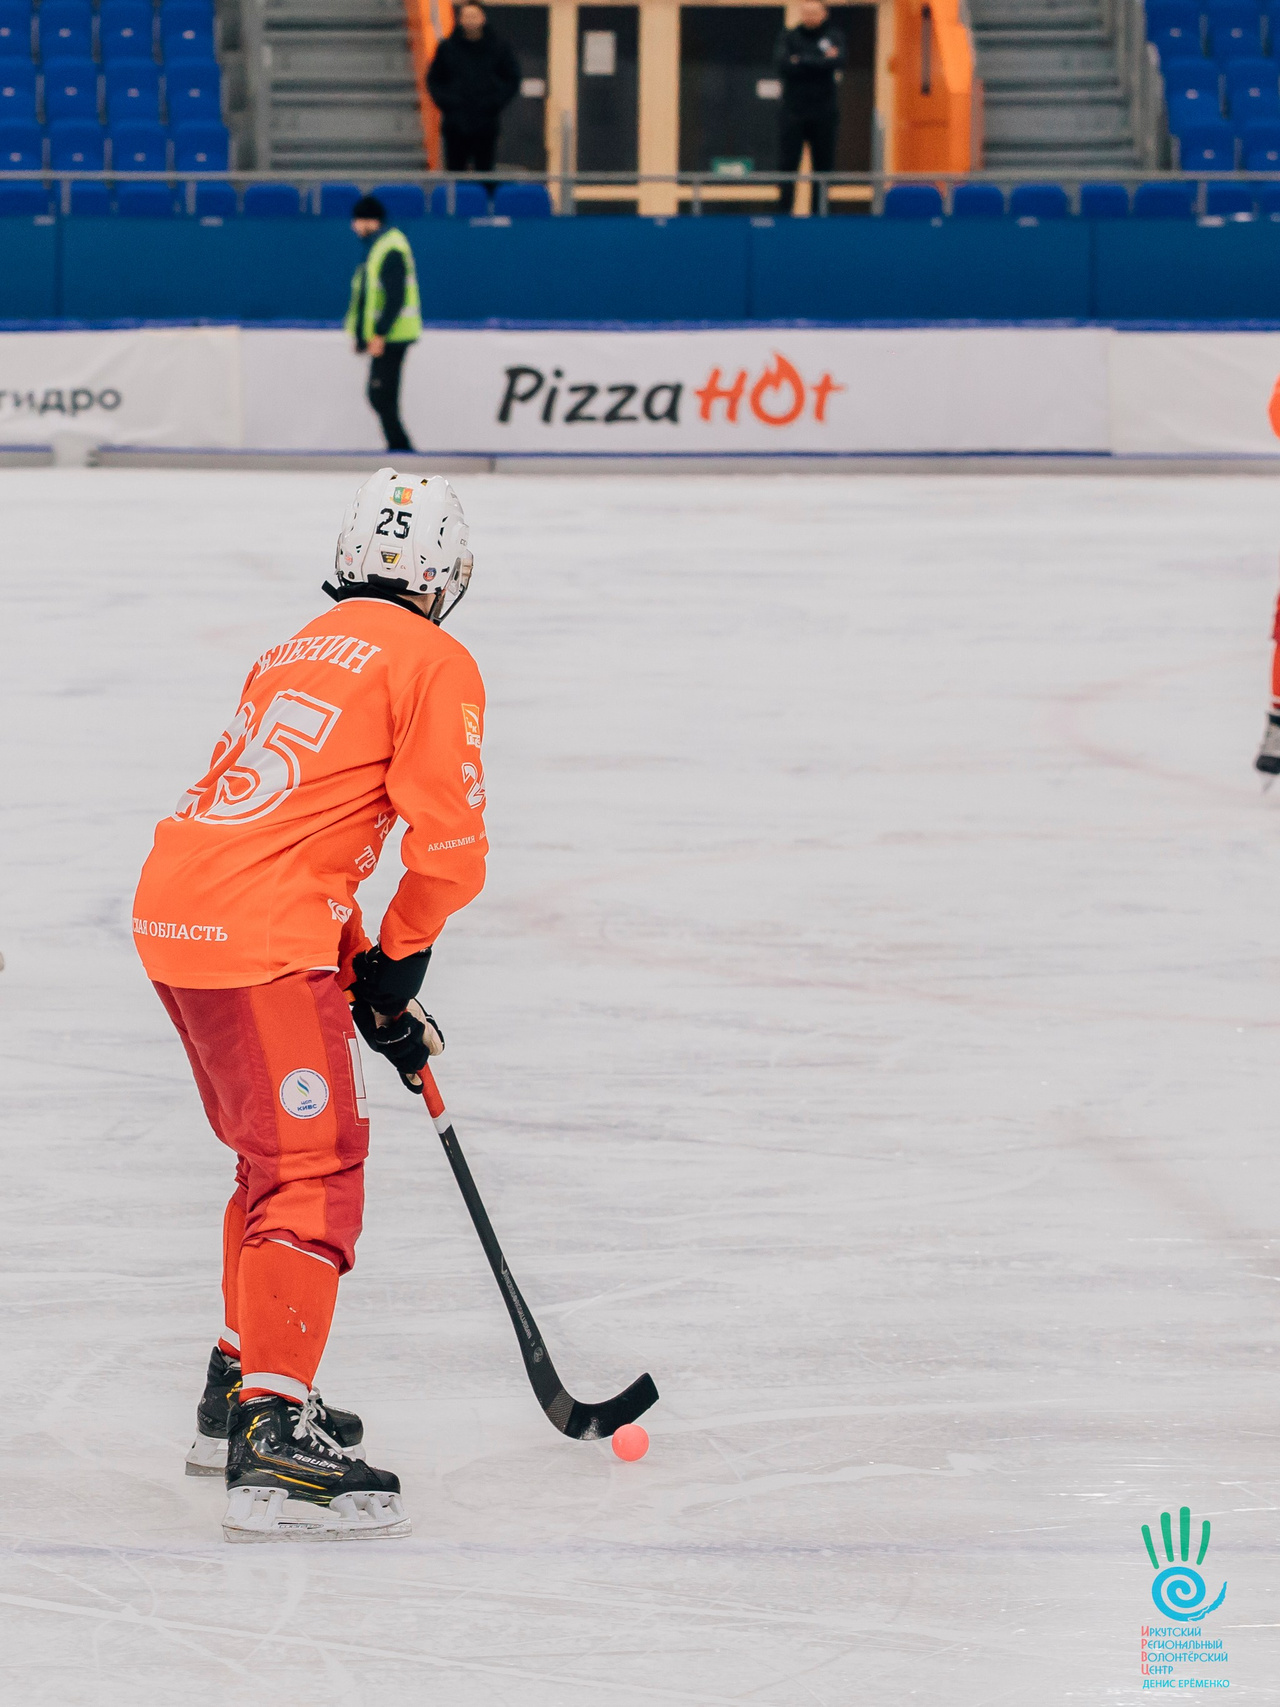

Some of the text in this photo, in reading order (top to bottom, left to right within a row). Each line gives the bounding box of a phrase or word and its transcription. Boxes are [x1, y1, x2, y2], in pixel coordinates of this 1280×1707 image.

[496, 364, 684, 426] Pizza
[375, 507, 413, 540] 25
[172, 688, 343, 825] 25
[427, 834, 476, 852] АКАДЕМИЯ
[354, 845, 378, 873] ТР
[149, 921, 229, 942] ОБЛАСТЬ
[297, 1103, 318, 1112] КИВС
